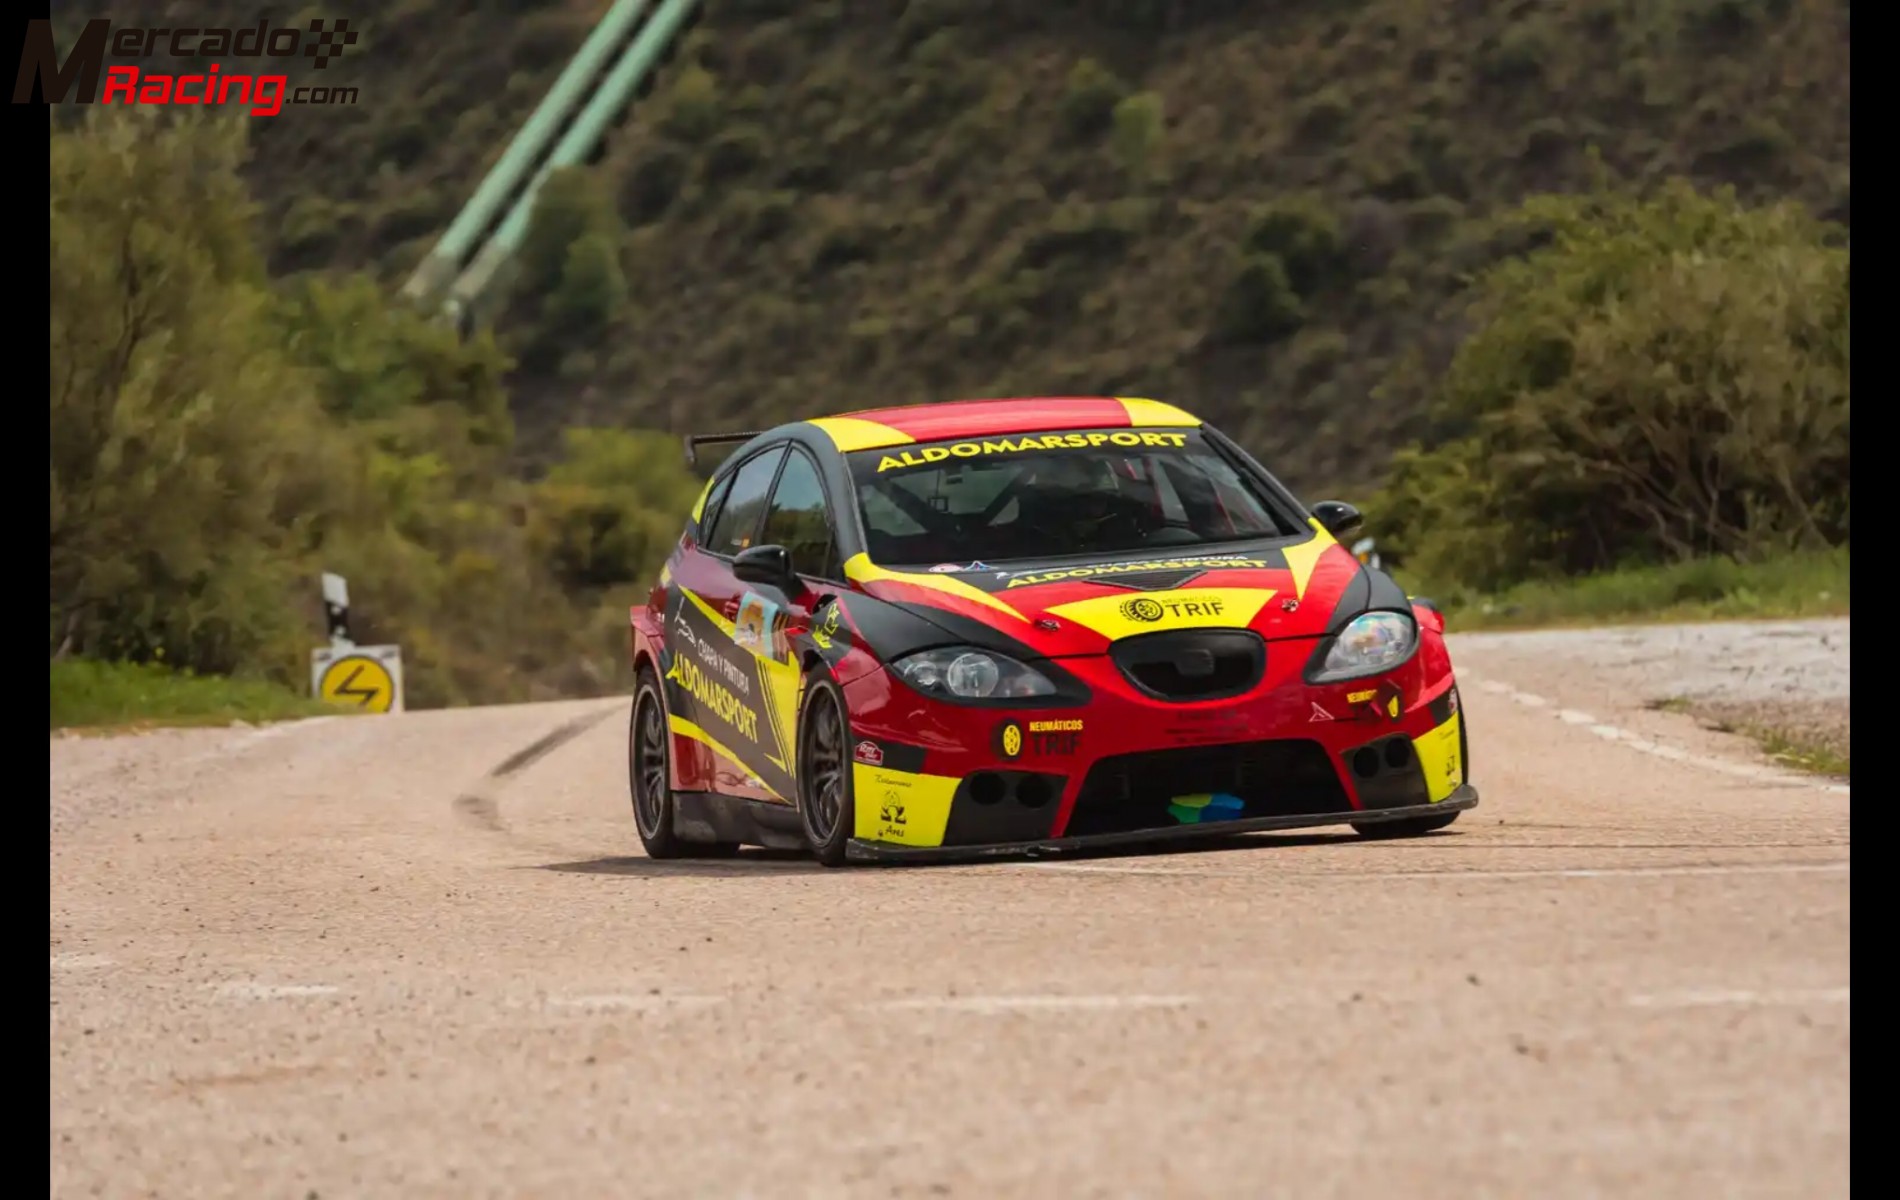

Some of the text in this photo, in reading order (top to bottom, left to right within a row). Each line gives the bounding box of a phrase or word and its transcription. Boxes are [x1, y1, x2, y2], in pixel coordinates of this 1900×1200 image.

[876, 431, 1188, 473] ALDOMARSPORT
[1007, 559, 1268, 588] ALDOMARSPORT
[1165, 602, 1225, 617] TRIF
[665, 650, 758, 743] ALDOMARSPORT
[1029, 718, 1083, 732] NEUMÁTICOS
